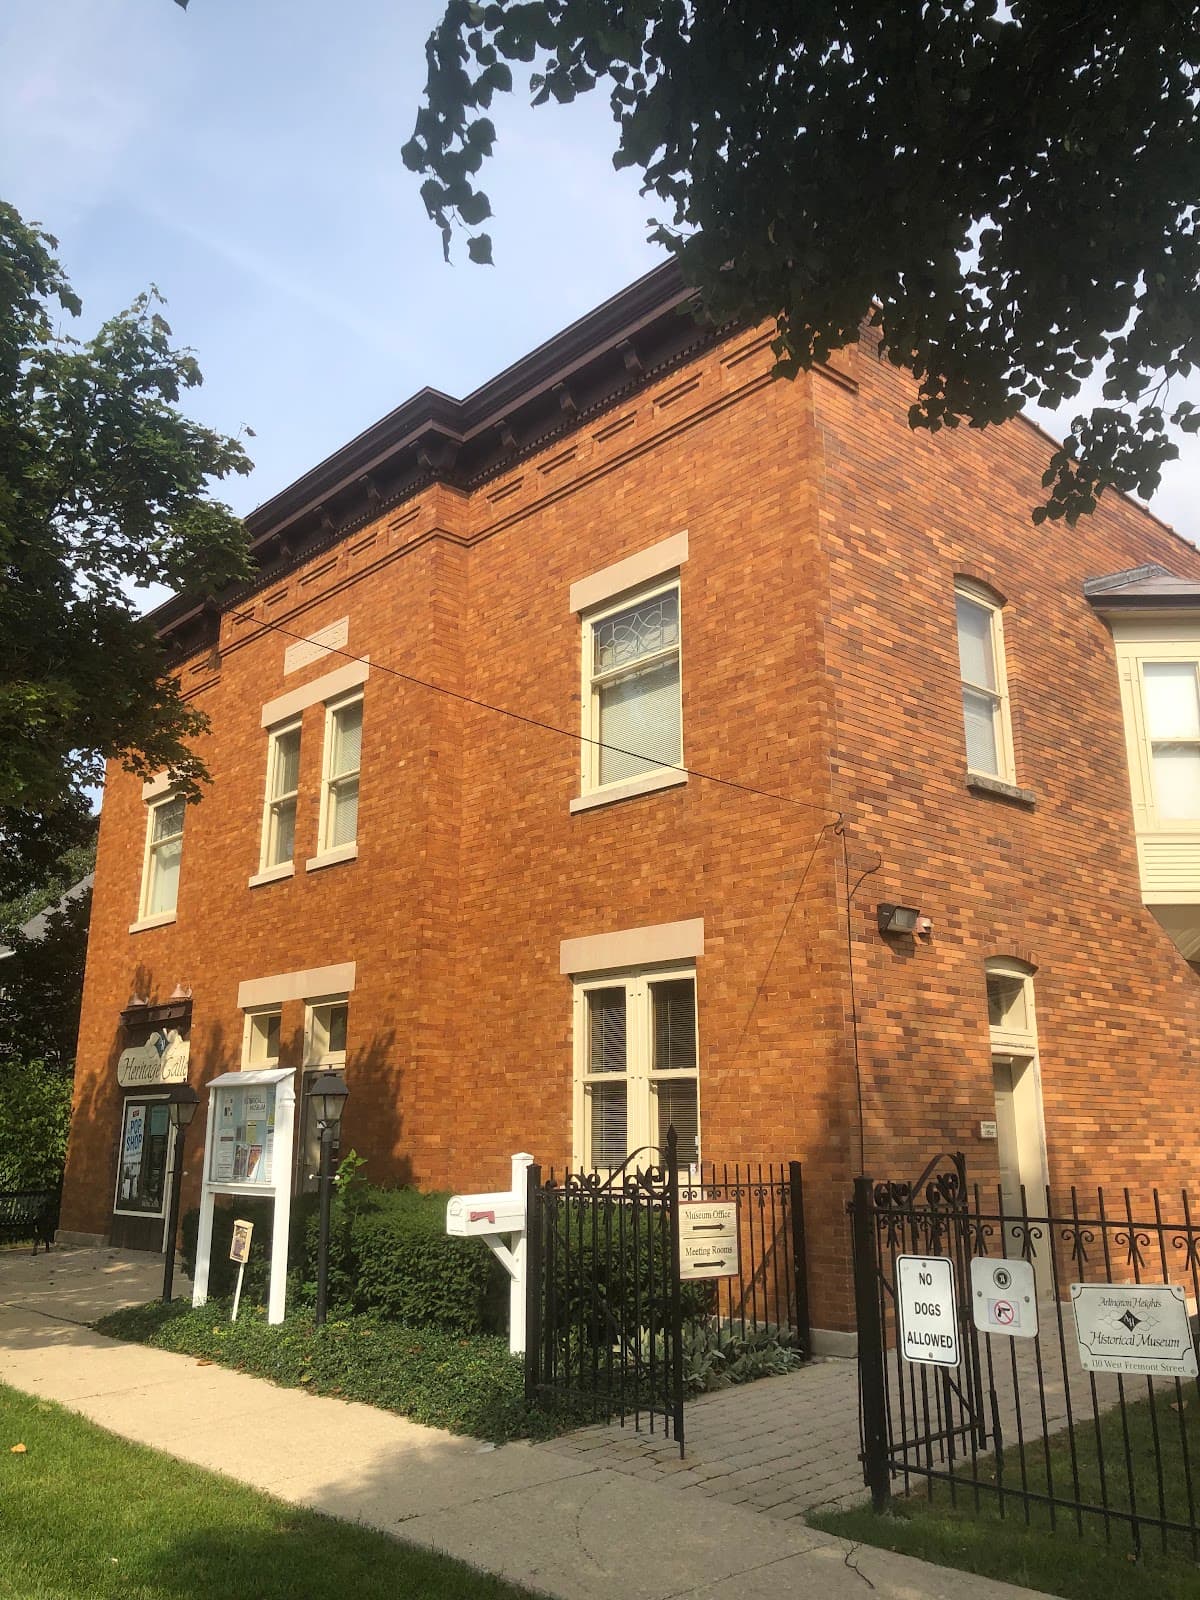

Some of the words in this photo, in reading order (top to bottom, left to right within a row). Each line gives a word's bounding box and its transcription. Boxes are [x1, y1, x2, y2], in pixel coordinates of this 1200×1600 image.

[121, 1057, 161, 1082] Heritage
[130, 1119, 142, 1133] POP
[126, 1134, 143, 1152] SHOP
[685, 1210, 712, 1220] Museum
[713, 1210, 731, 1219] Office
[685, 1247, 711, 1256] Meeting
[712, 1246, 732, 1254] Rooms
[919, 1272, 932, 1286] NO
[914, 1302, 941, 1317] DOGS
[1098, 1297, 1132, 1309] Arlington
[1131, 1298, 1162, 1309] Heights
[907, 1330, 953, 1349] ALLOWED
[1090, 1331, 1136, 1346] Historical
[1136, 1333, 1180, 1348] Museum
[1104, 1360, 1122, 1369] West
[1124, 1361, 1158, 1371] Fremont
[1160, 1363, 1186, 1373] Street
